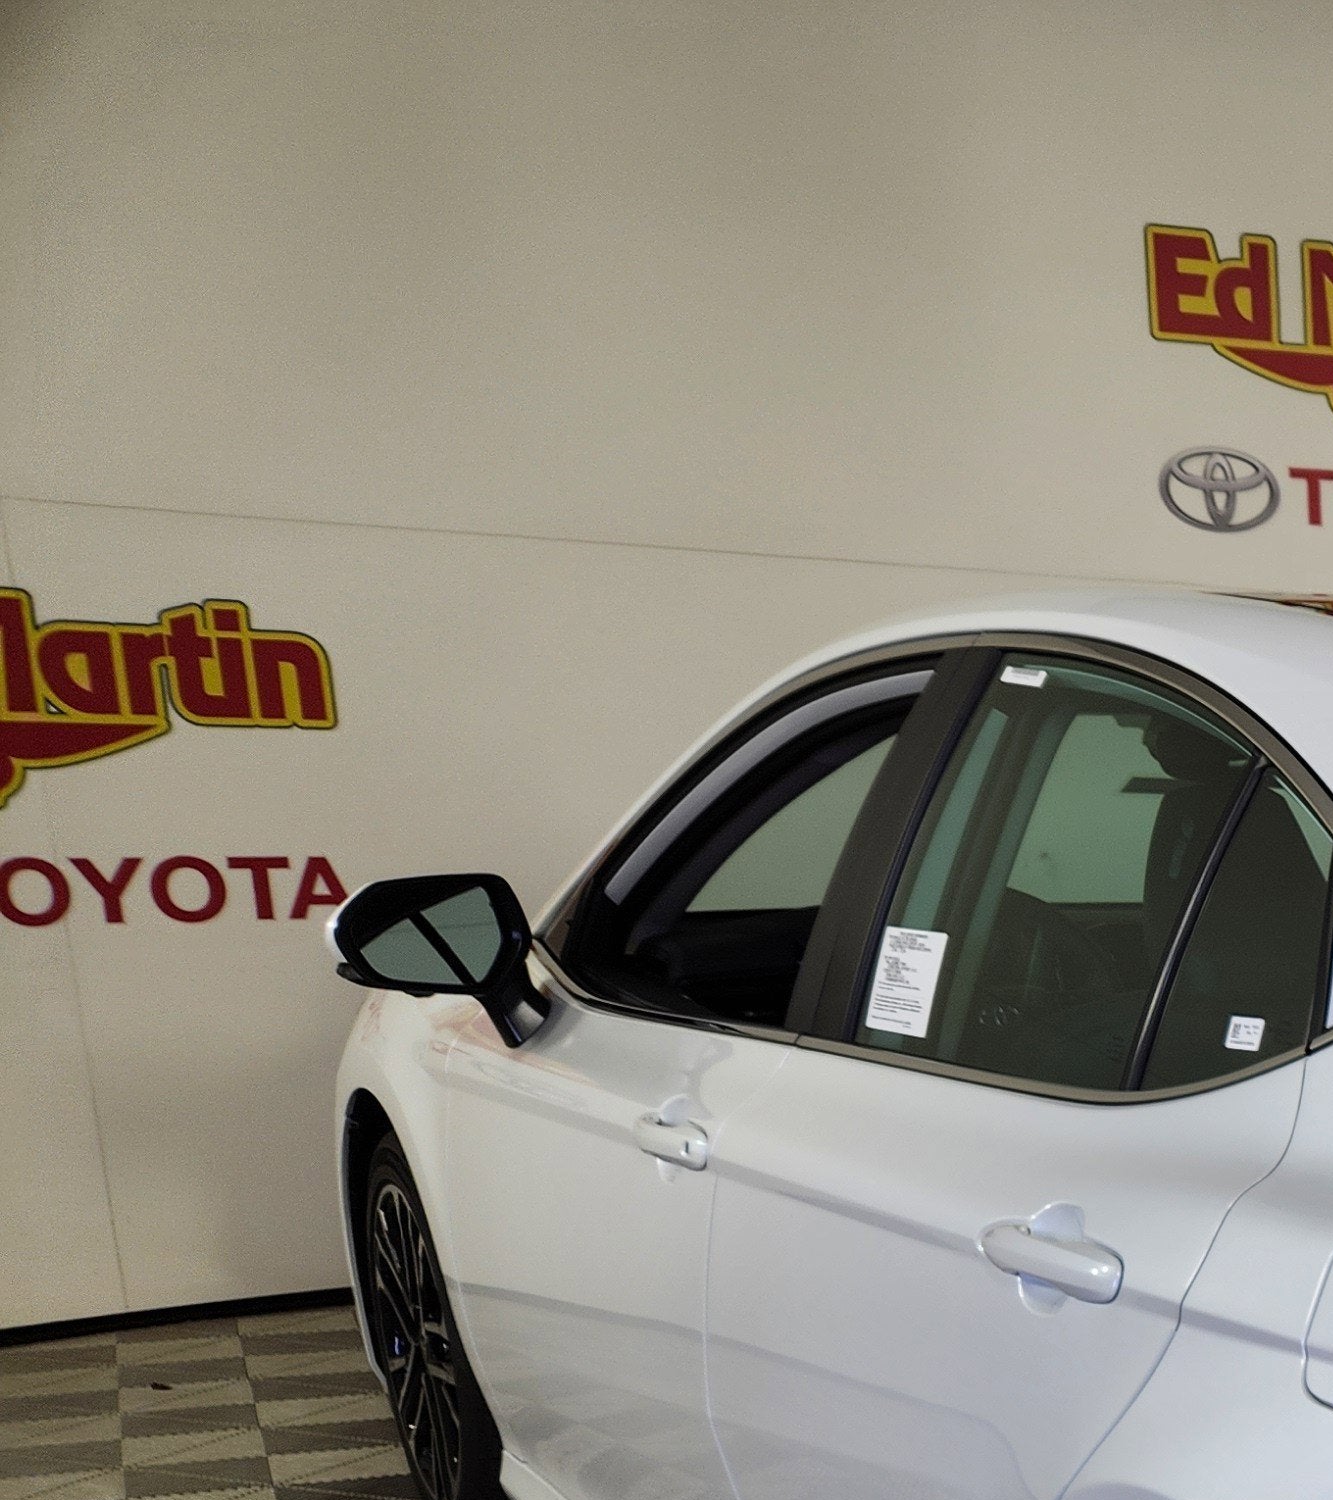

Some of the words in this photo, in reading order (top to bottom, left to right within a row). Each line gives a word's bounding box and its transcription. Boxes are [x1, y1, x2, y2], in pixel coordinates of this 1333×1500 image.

[1147, 225, 1278, 344] Ed
[0, 588, 336, 728] artin
[0, 856, 350, 926] OYOTA
